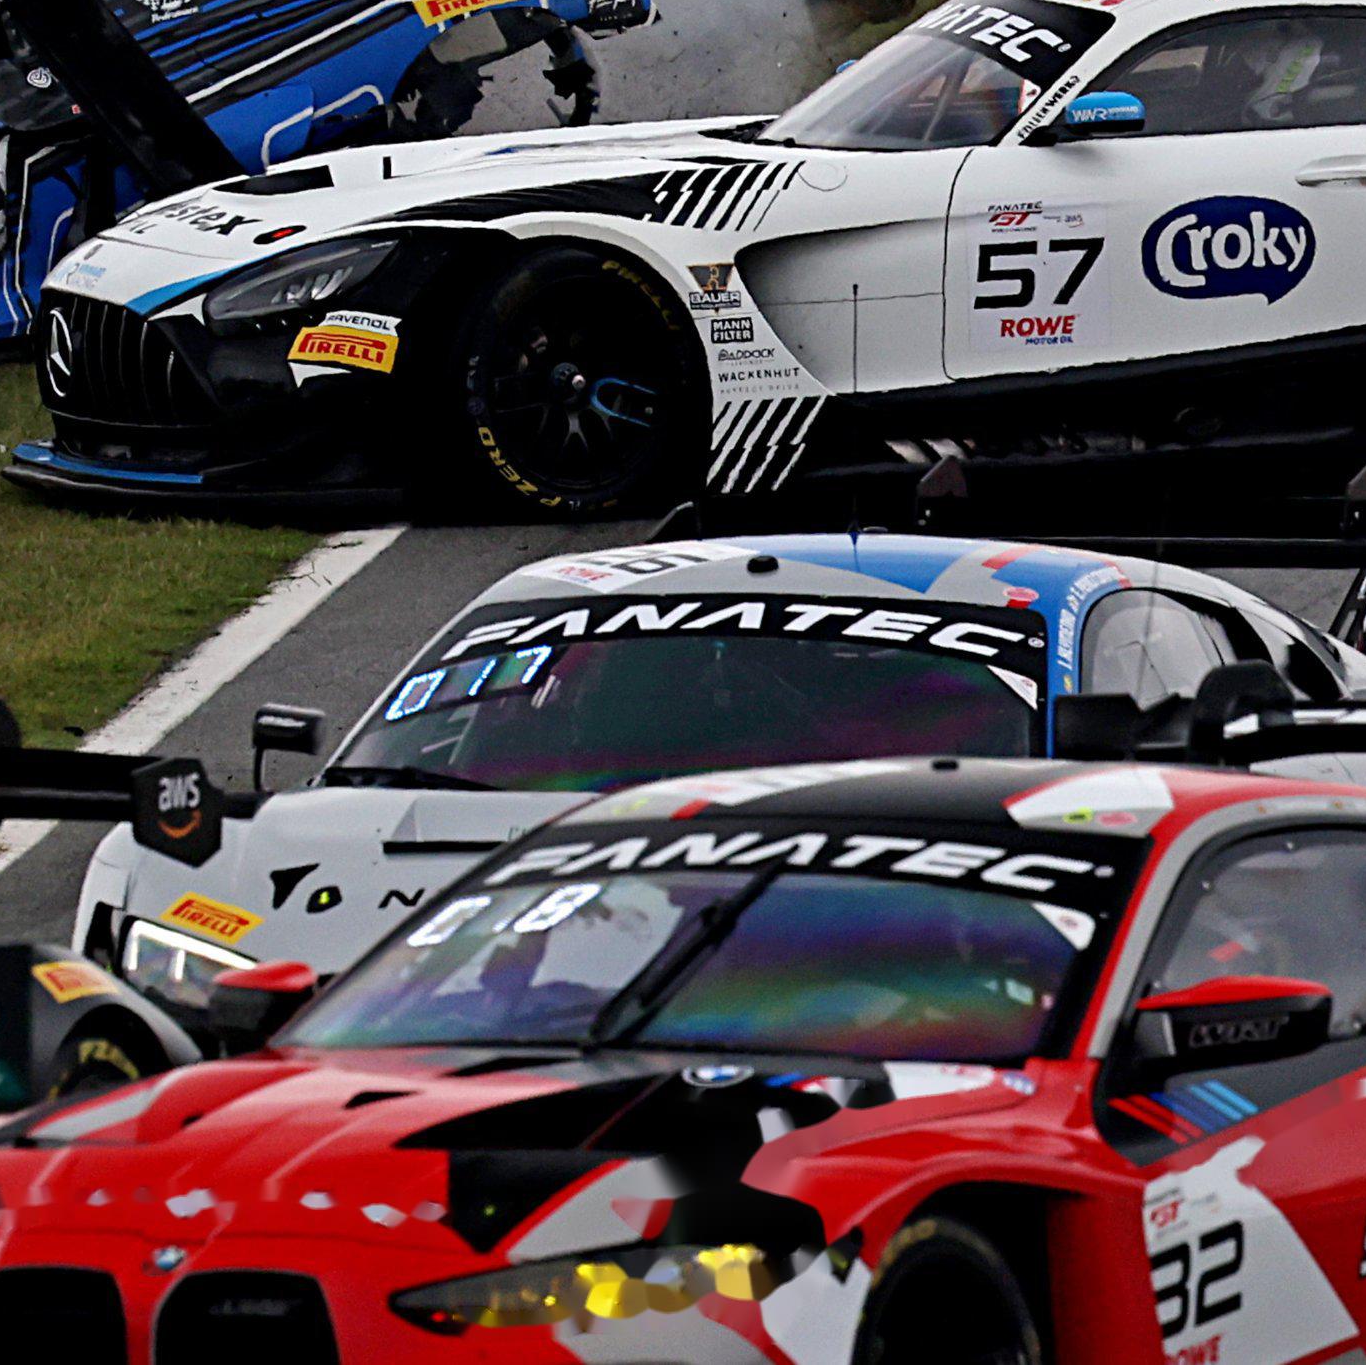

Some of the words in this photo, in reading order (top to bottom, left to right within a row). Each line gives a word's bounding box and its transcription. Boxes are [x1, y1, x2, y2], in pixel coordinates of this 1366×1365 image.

[988, 200, 1043, 212] FANATEC
[1155, 211, 1307, 288] Croky
[973, 236, 1105, 310] 57
[327, 313, 391, 331] RAVENOL
[713, 319, 751, 331] MANN
[713, 330, 752, 342] FILTER
[1000, 314, 1076, 338] ROWE
[298, 331, 387, 364] PIRELLI
[718, 367, 800, 383] WACKENHUT
[441, 601, 1025, 661] FANATEC
[385, 644, 553, 722] 017
[157, 773, 201, 811] aws
[484, 834, 1095, 892] FANATEC
[181, 898, 251, 937] PIRELLI
[1149, 1219, 1244, 1340] 32
